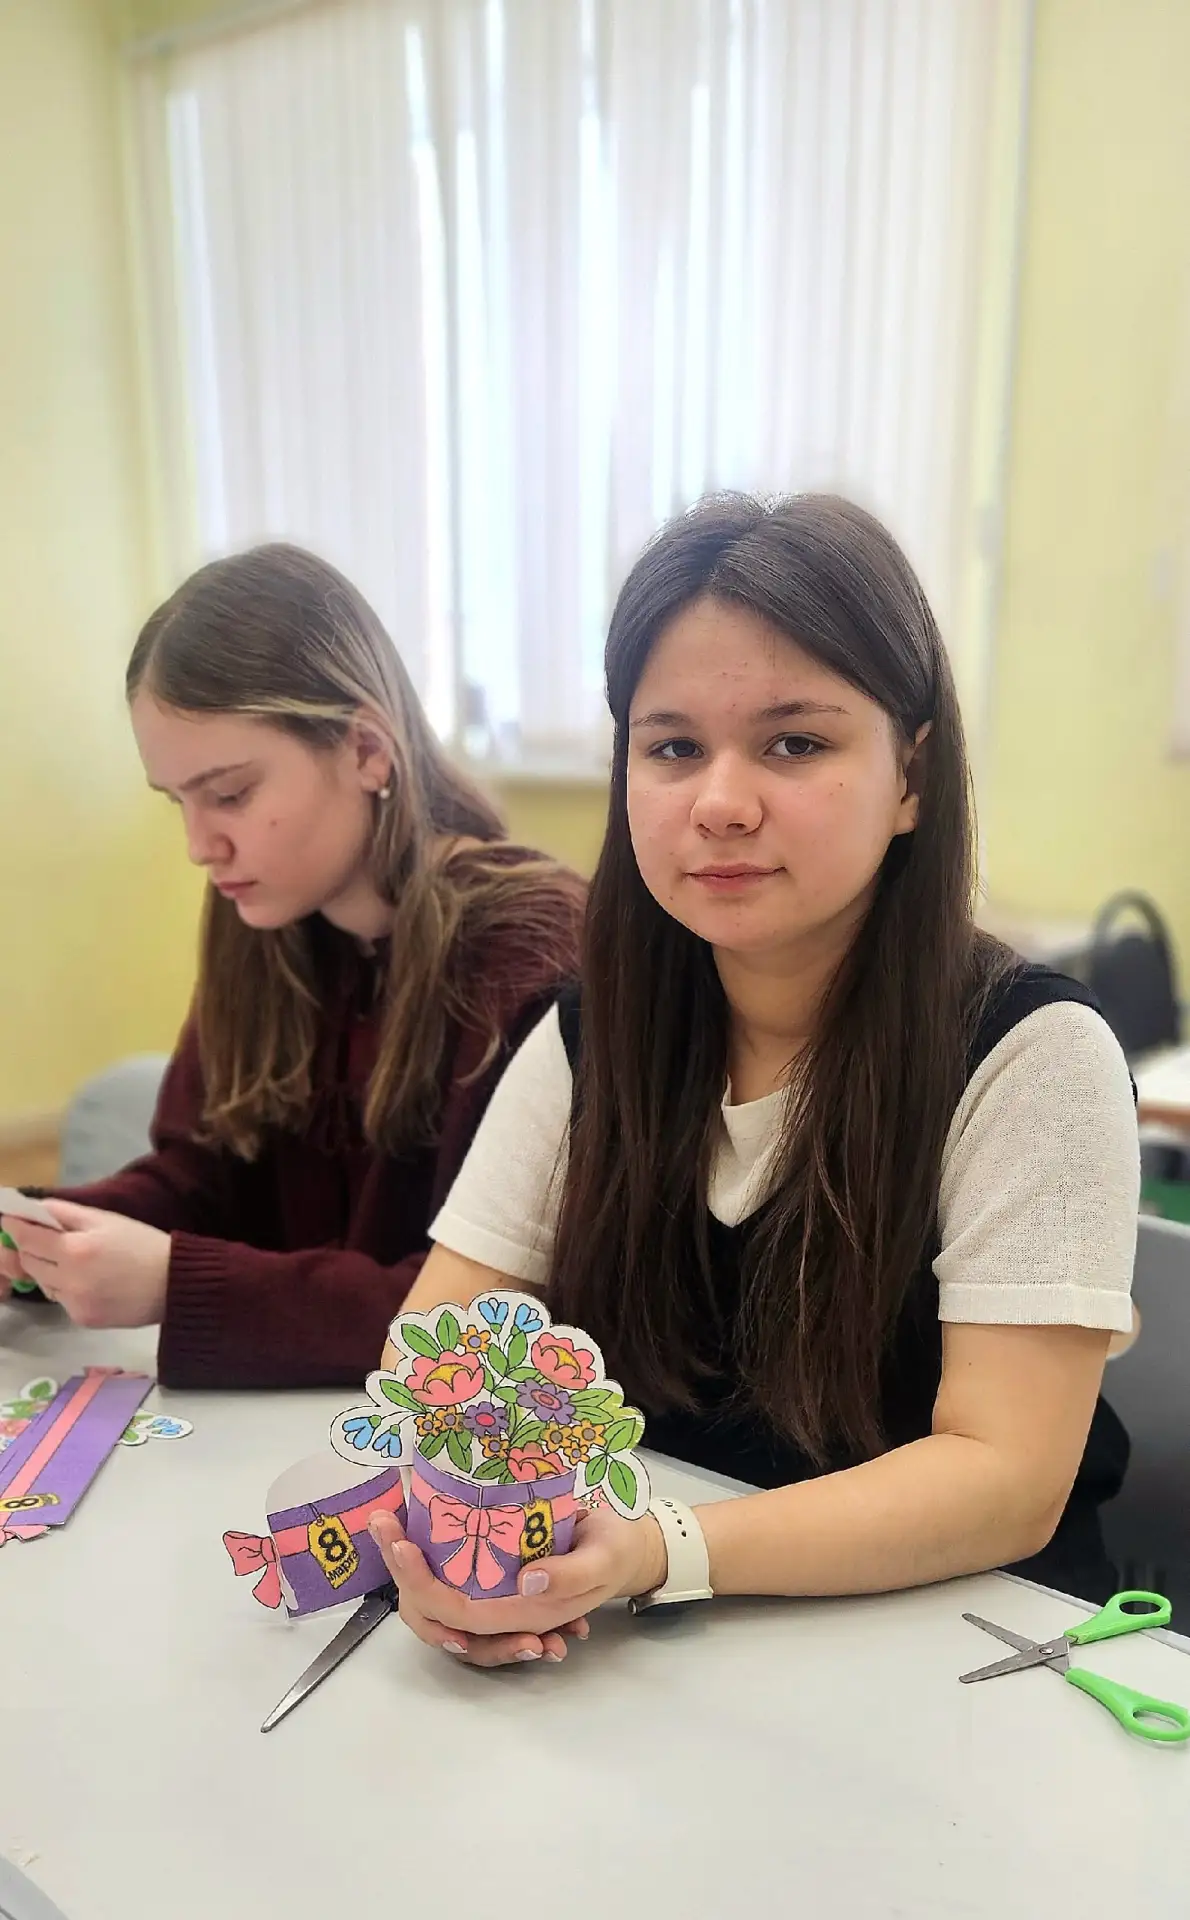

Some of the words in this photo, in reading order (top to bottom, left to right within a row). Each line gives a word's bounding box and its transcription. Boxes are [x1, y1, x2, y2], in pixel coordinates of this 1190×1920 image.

[4, 1498, 40, 1509] 8
[318, 1527, 348, 1562] 8
[525, 1511, 549, 1549] 8
